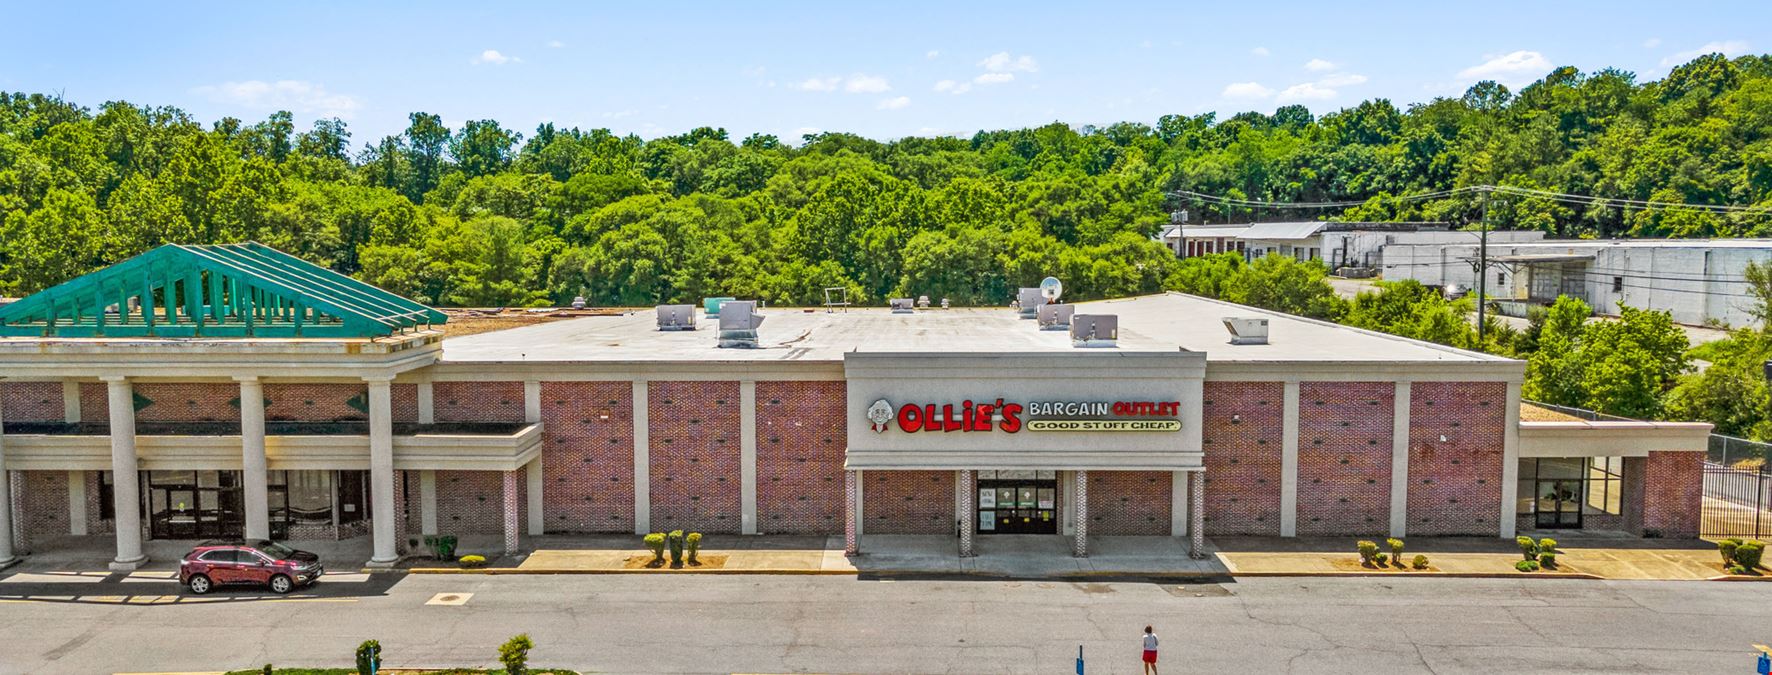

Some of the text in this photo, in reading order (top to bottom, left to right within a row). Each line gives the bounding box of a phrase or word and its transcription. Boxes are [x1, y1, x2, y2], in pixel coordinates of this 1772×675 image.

[1029, 401, 1180, 416] BARGAIN OUTLET
[1082, 421, 1129, 429] STUFF
